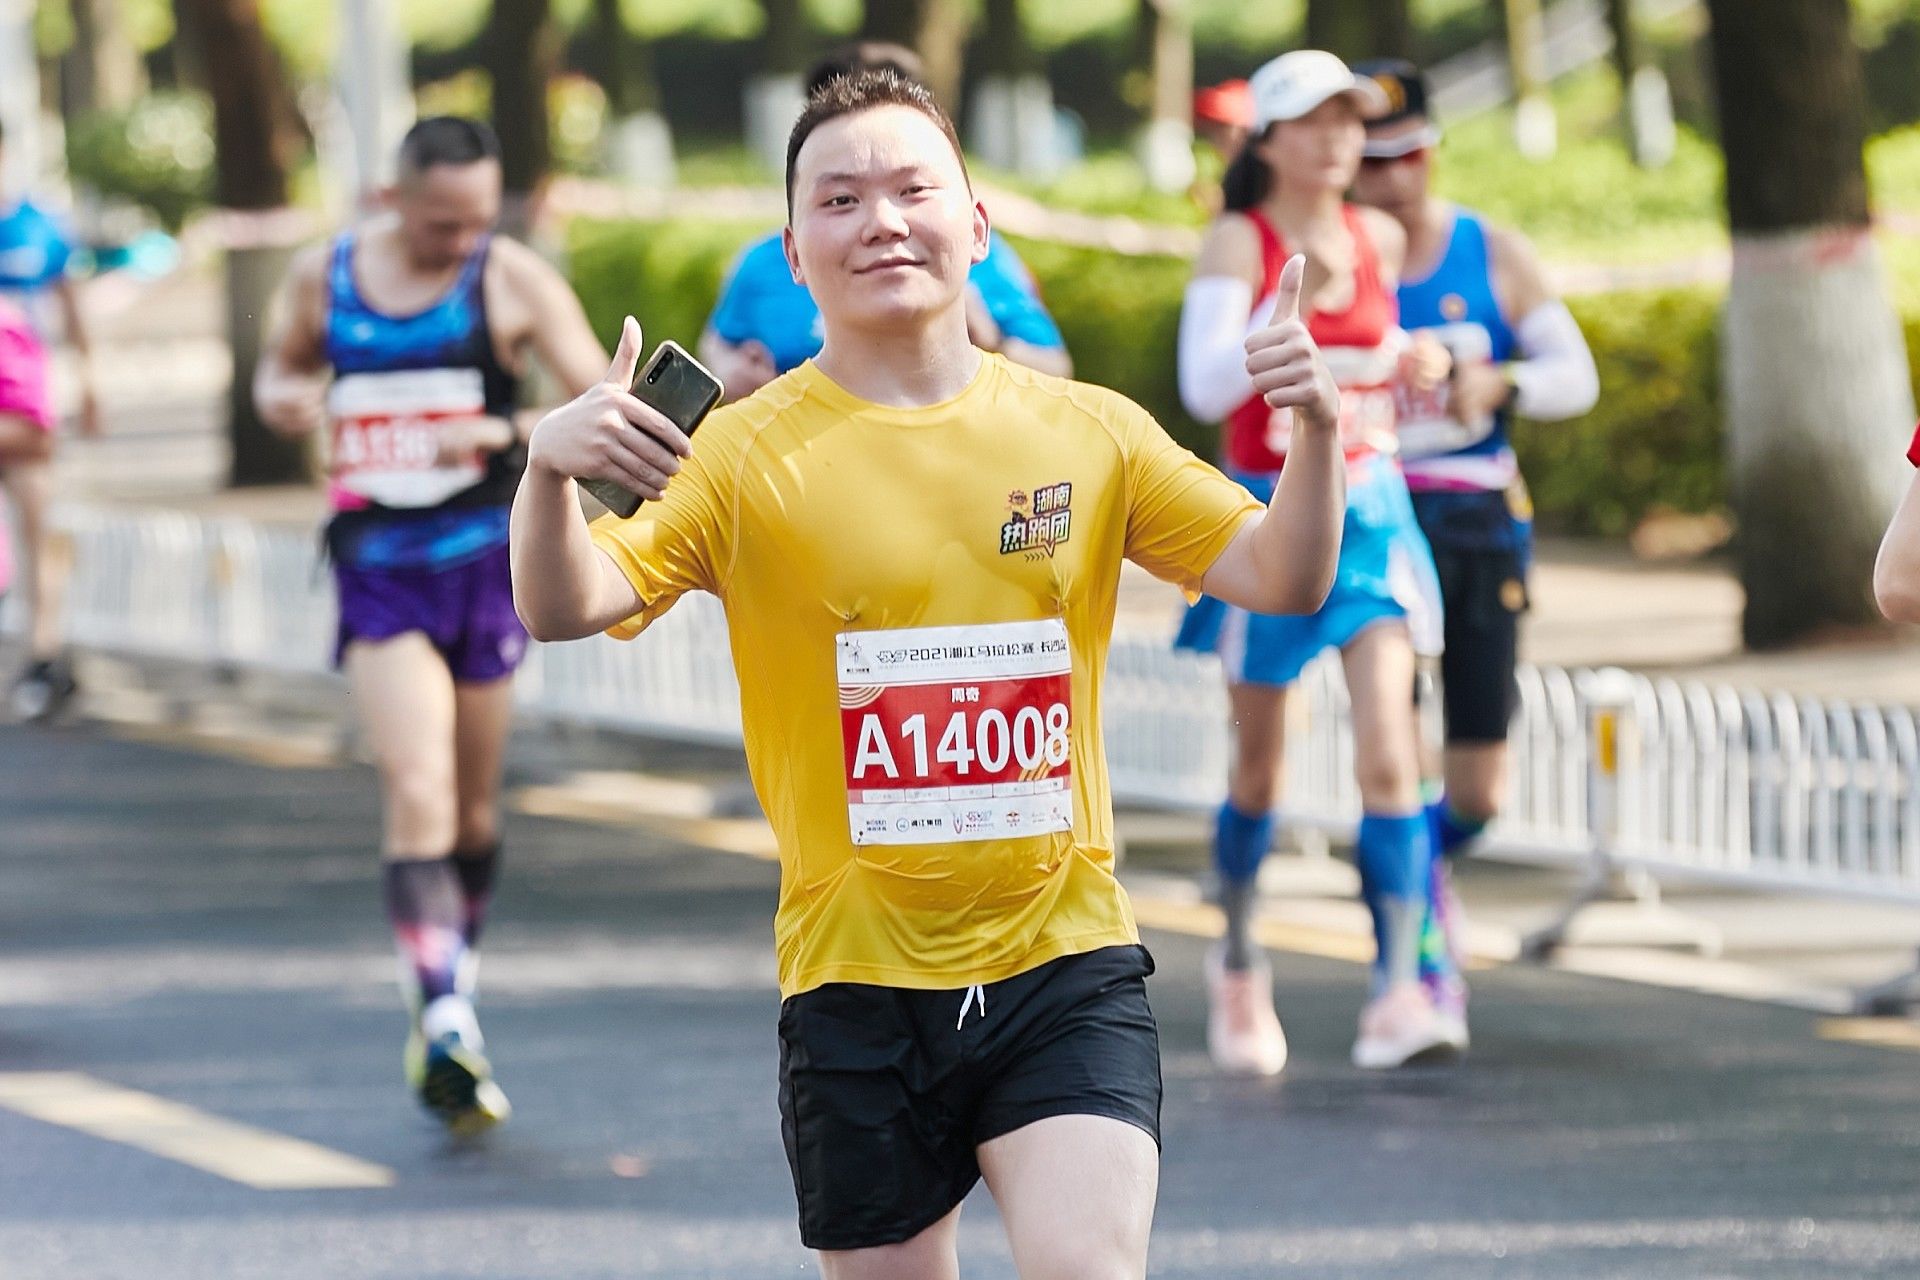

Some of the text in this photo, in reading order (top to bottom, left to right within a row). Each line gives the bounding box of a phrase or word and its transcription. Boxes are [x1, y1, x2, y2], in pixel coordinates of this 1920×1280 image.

[1034, 483, 1071, 514] 湖南
[1001, 511, 1071, 553] 热跑团
[852, 702, 1070, 779] A14008
